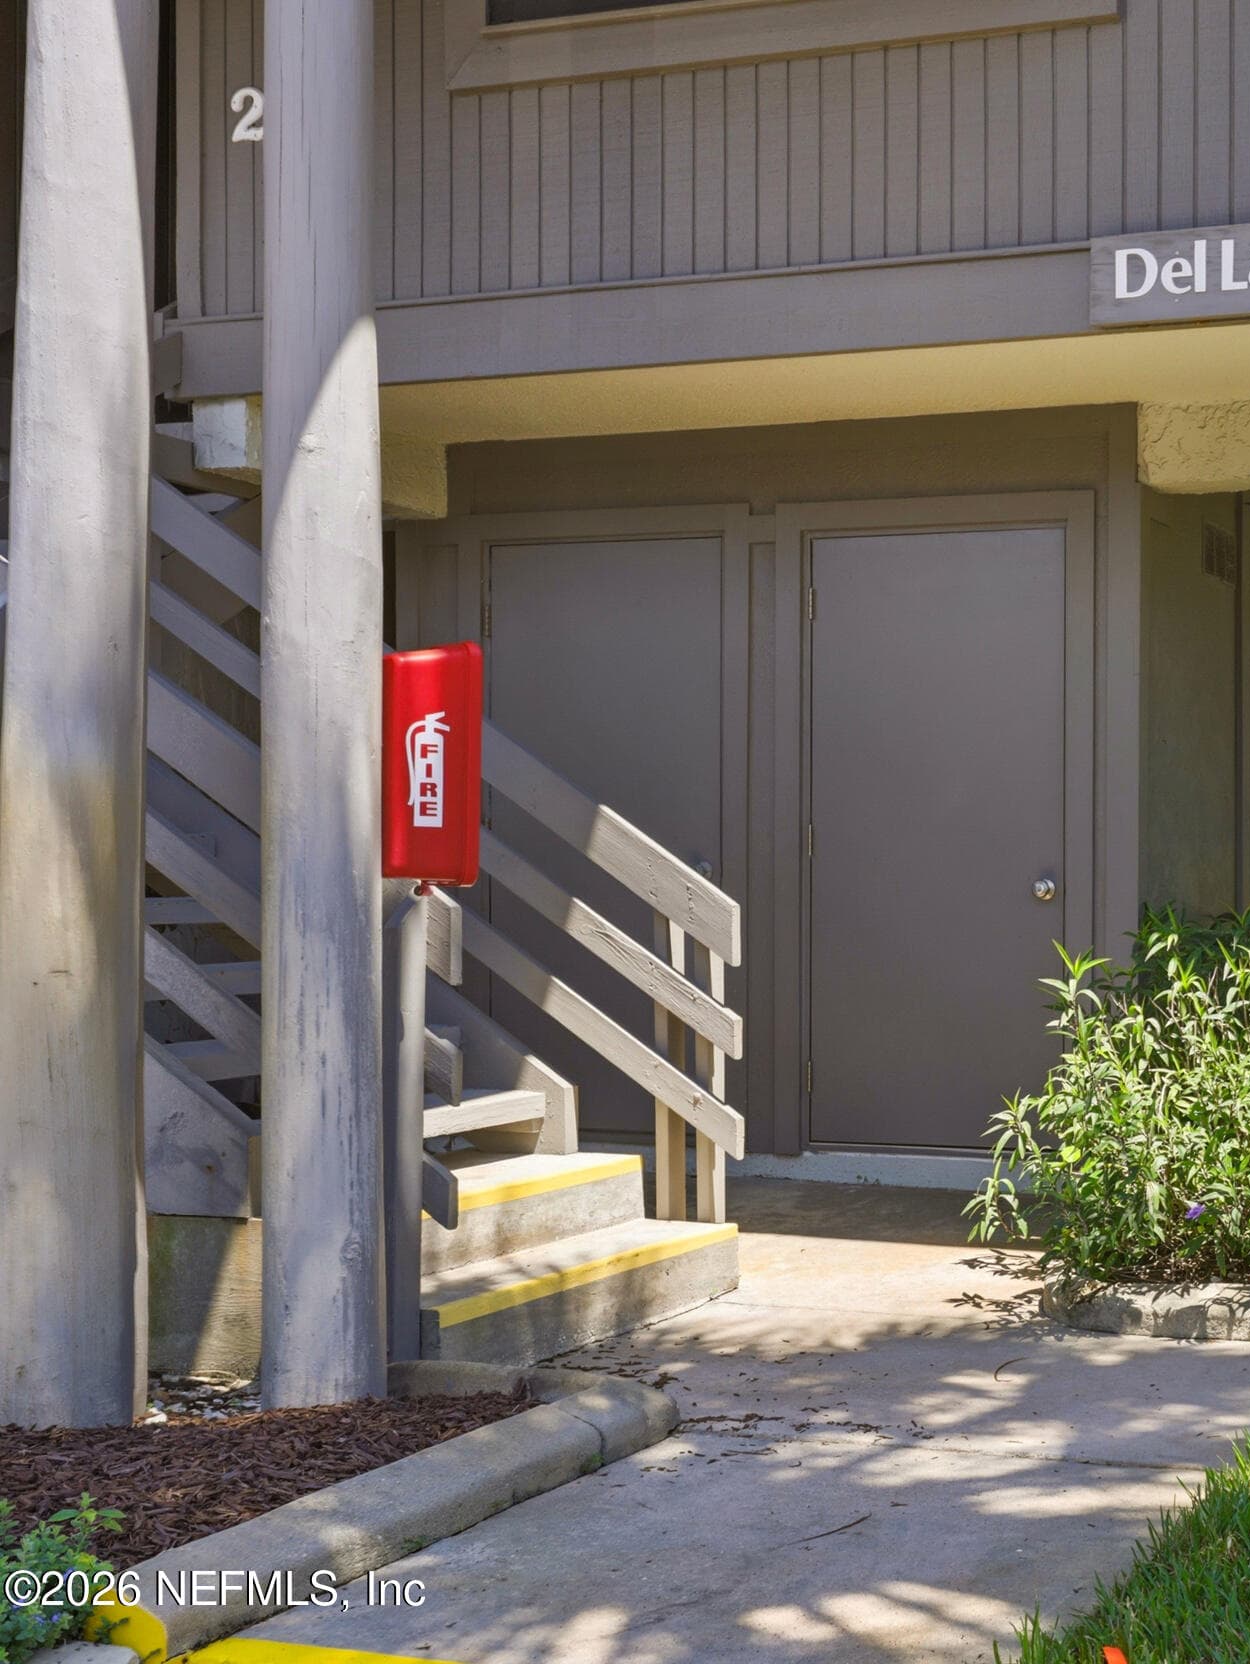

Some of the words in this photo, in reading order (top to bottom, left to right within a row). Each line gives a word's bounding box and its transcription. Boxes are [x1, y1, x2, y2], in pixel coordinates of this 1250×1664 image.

[231, 87, 264, 142] 2
[1114, 239, 1207, 299] Del
[419, 743, 438, 817] FIRE
